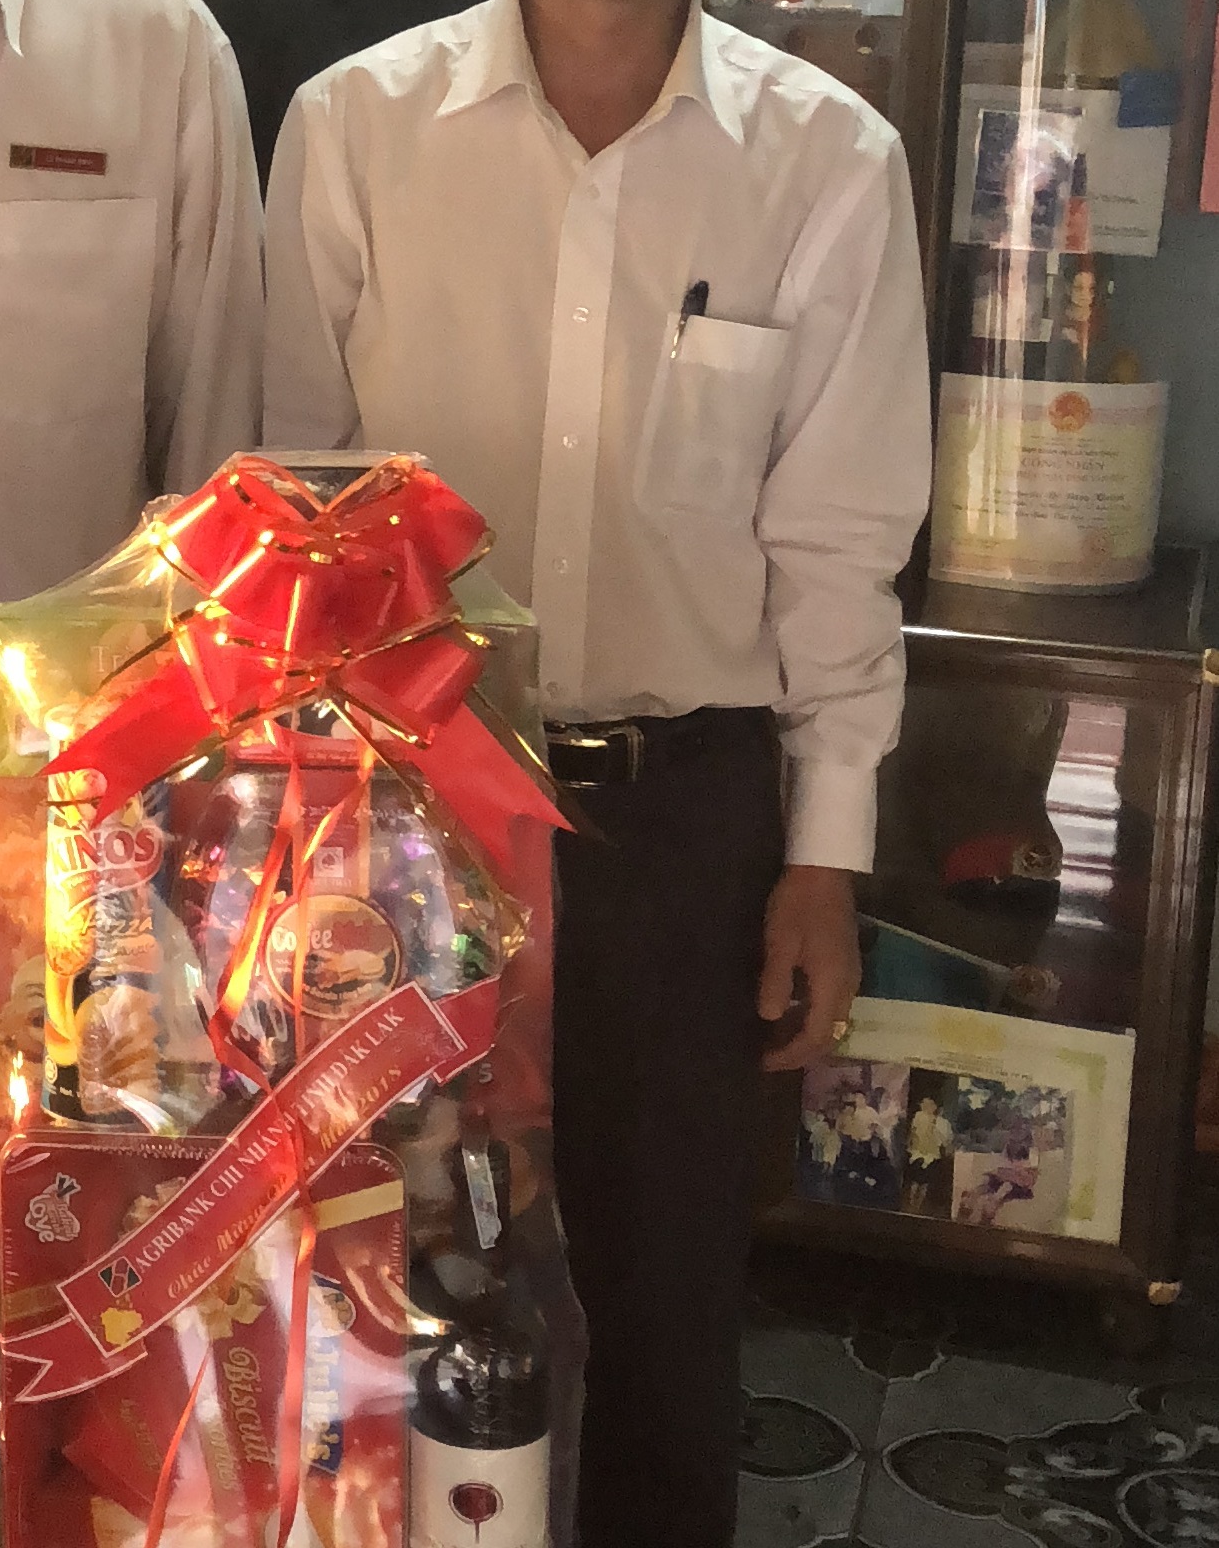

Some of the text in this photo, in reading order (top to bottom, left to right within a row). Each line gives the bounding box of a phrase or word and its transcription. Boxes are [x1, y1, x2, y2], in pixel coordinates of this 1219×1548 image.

[271, 925, 333, 952] Coee
[134, 1194, 216, 1274] AGRIBANK
[209, 1163, 246, 1200] CHI
